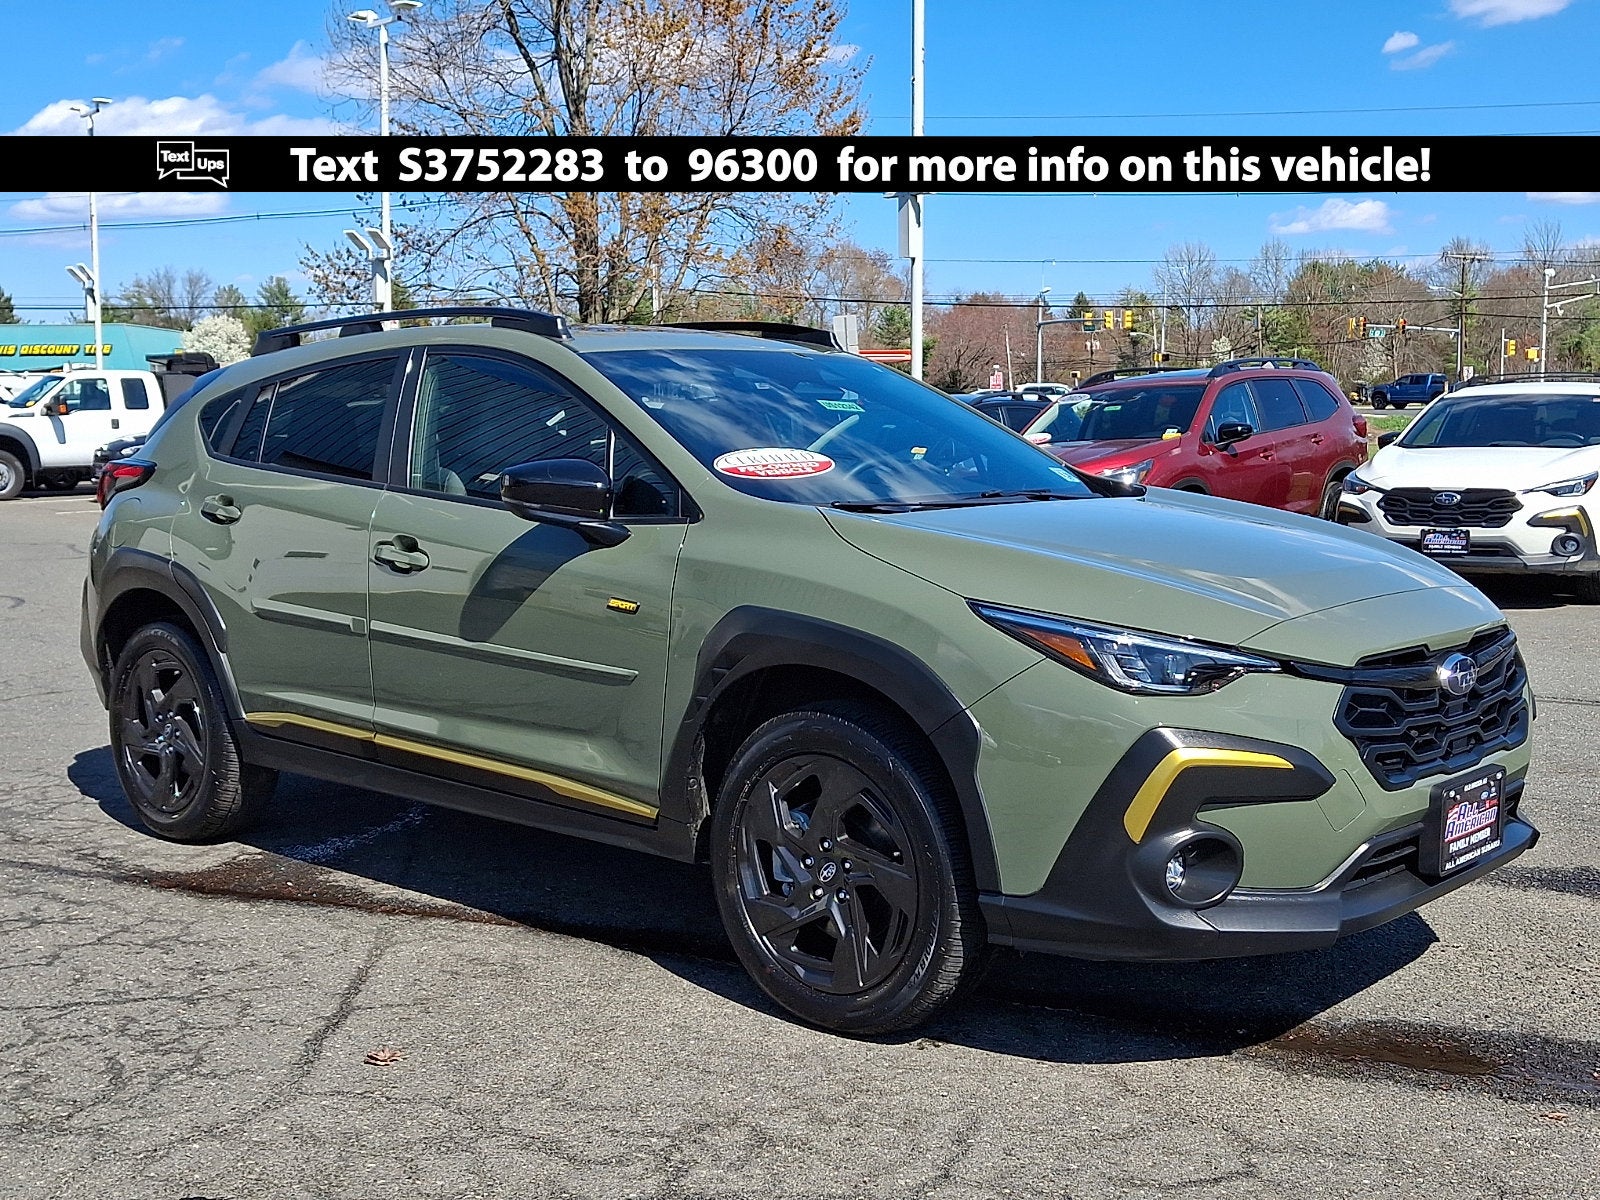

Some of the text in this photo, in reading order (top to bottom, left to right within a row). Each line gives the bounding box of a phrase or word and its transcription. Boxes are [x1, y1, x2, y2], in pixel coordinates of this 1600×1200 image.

[20, 344, 79, 355] DISCOUNT
[1445, 807, 1498, 840] AMERICAN
[1449, 837, 1470, 854] FAMILY
[1445, 860, 1456, 870] ALL
[1456, 849, 1480, 865] AMERICAN
